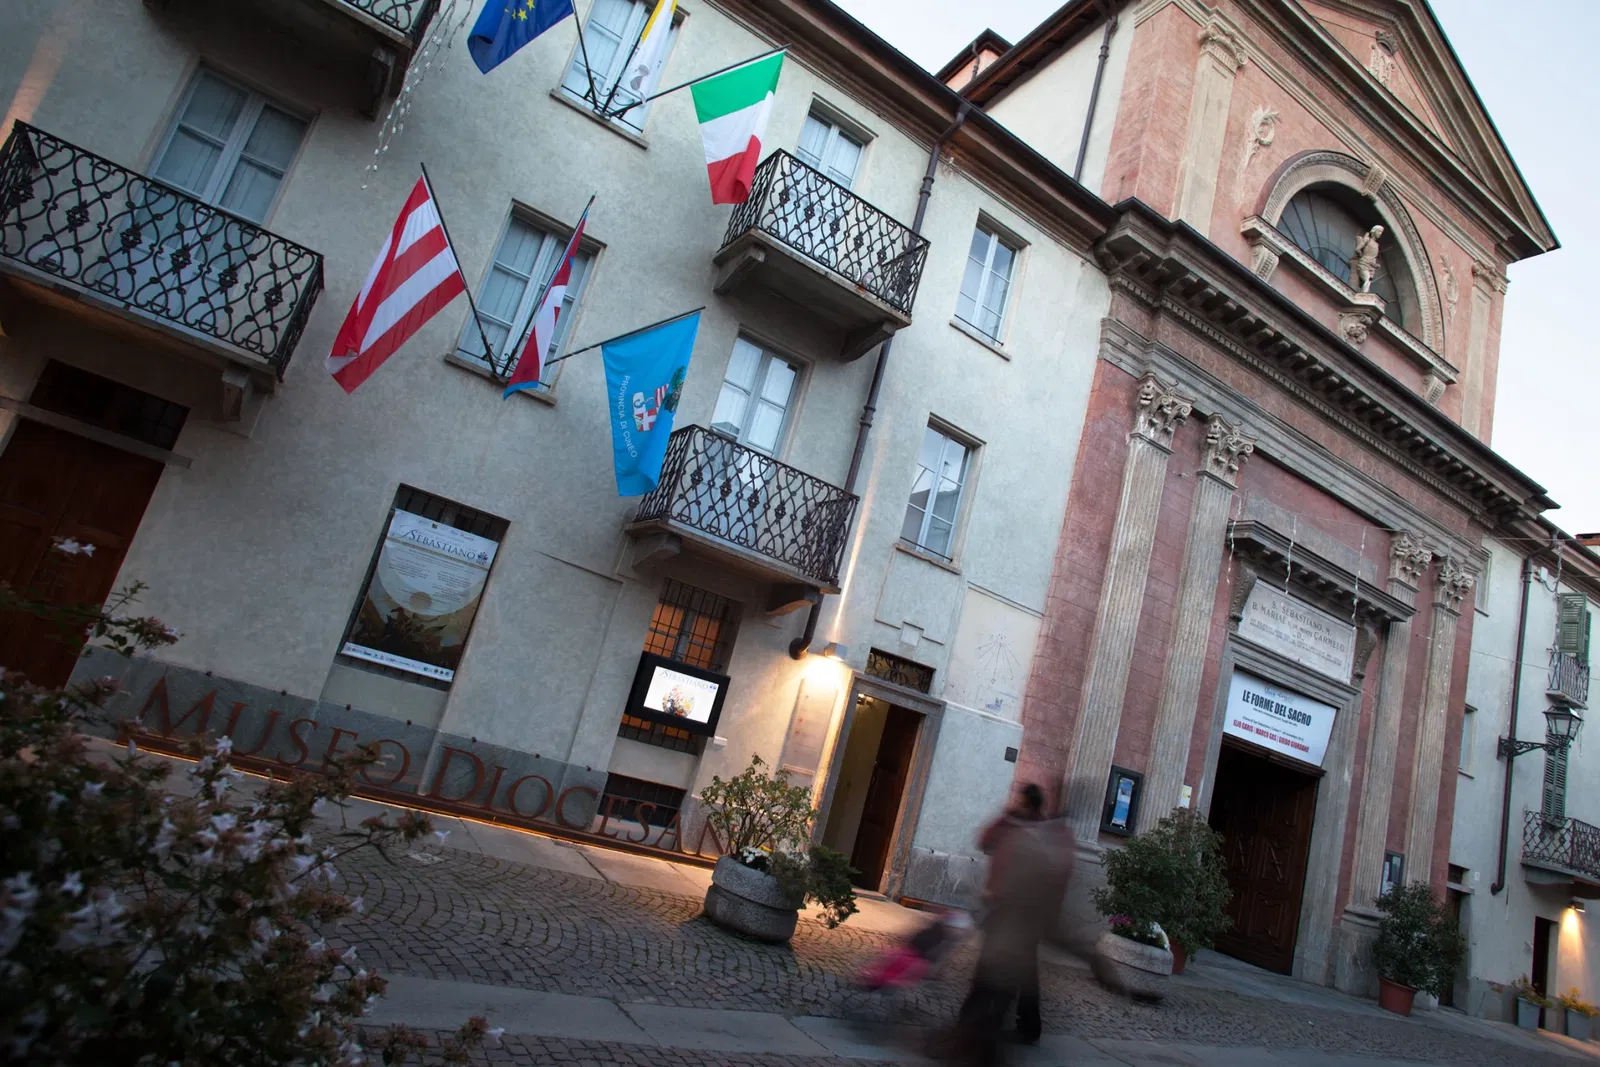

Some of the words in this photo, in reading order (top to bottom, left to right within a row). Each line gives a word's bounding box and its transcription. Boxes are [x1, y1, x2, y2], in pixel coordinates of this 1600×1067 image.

[618, 375, 630, 418] PROVINCIA
[620, 421, 627, 429] DI
[623, 431, 637, 457] CUNEO
[402, 529, 476, 560] SEBASTIANO
[1313, 631, 1345, 652] CARMELO
[1242, 689, 1251, 703] LE
[1251, 693, 1274, 713] FORME
[1274, 703, 1287, 718] DEL
[1287, 707, 1312, 727] SACRO
[1256, 727, 1269, 738] MARCO
[138, 675, 411, 787] MUSEO
[430, 745, 739, 857] DIOCESAN
